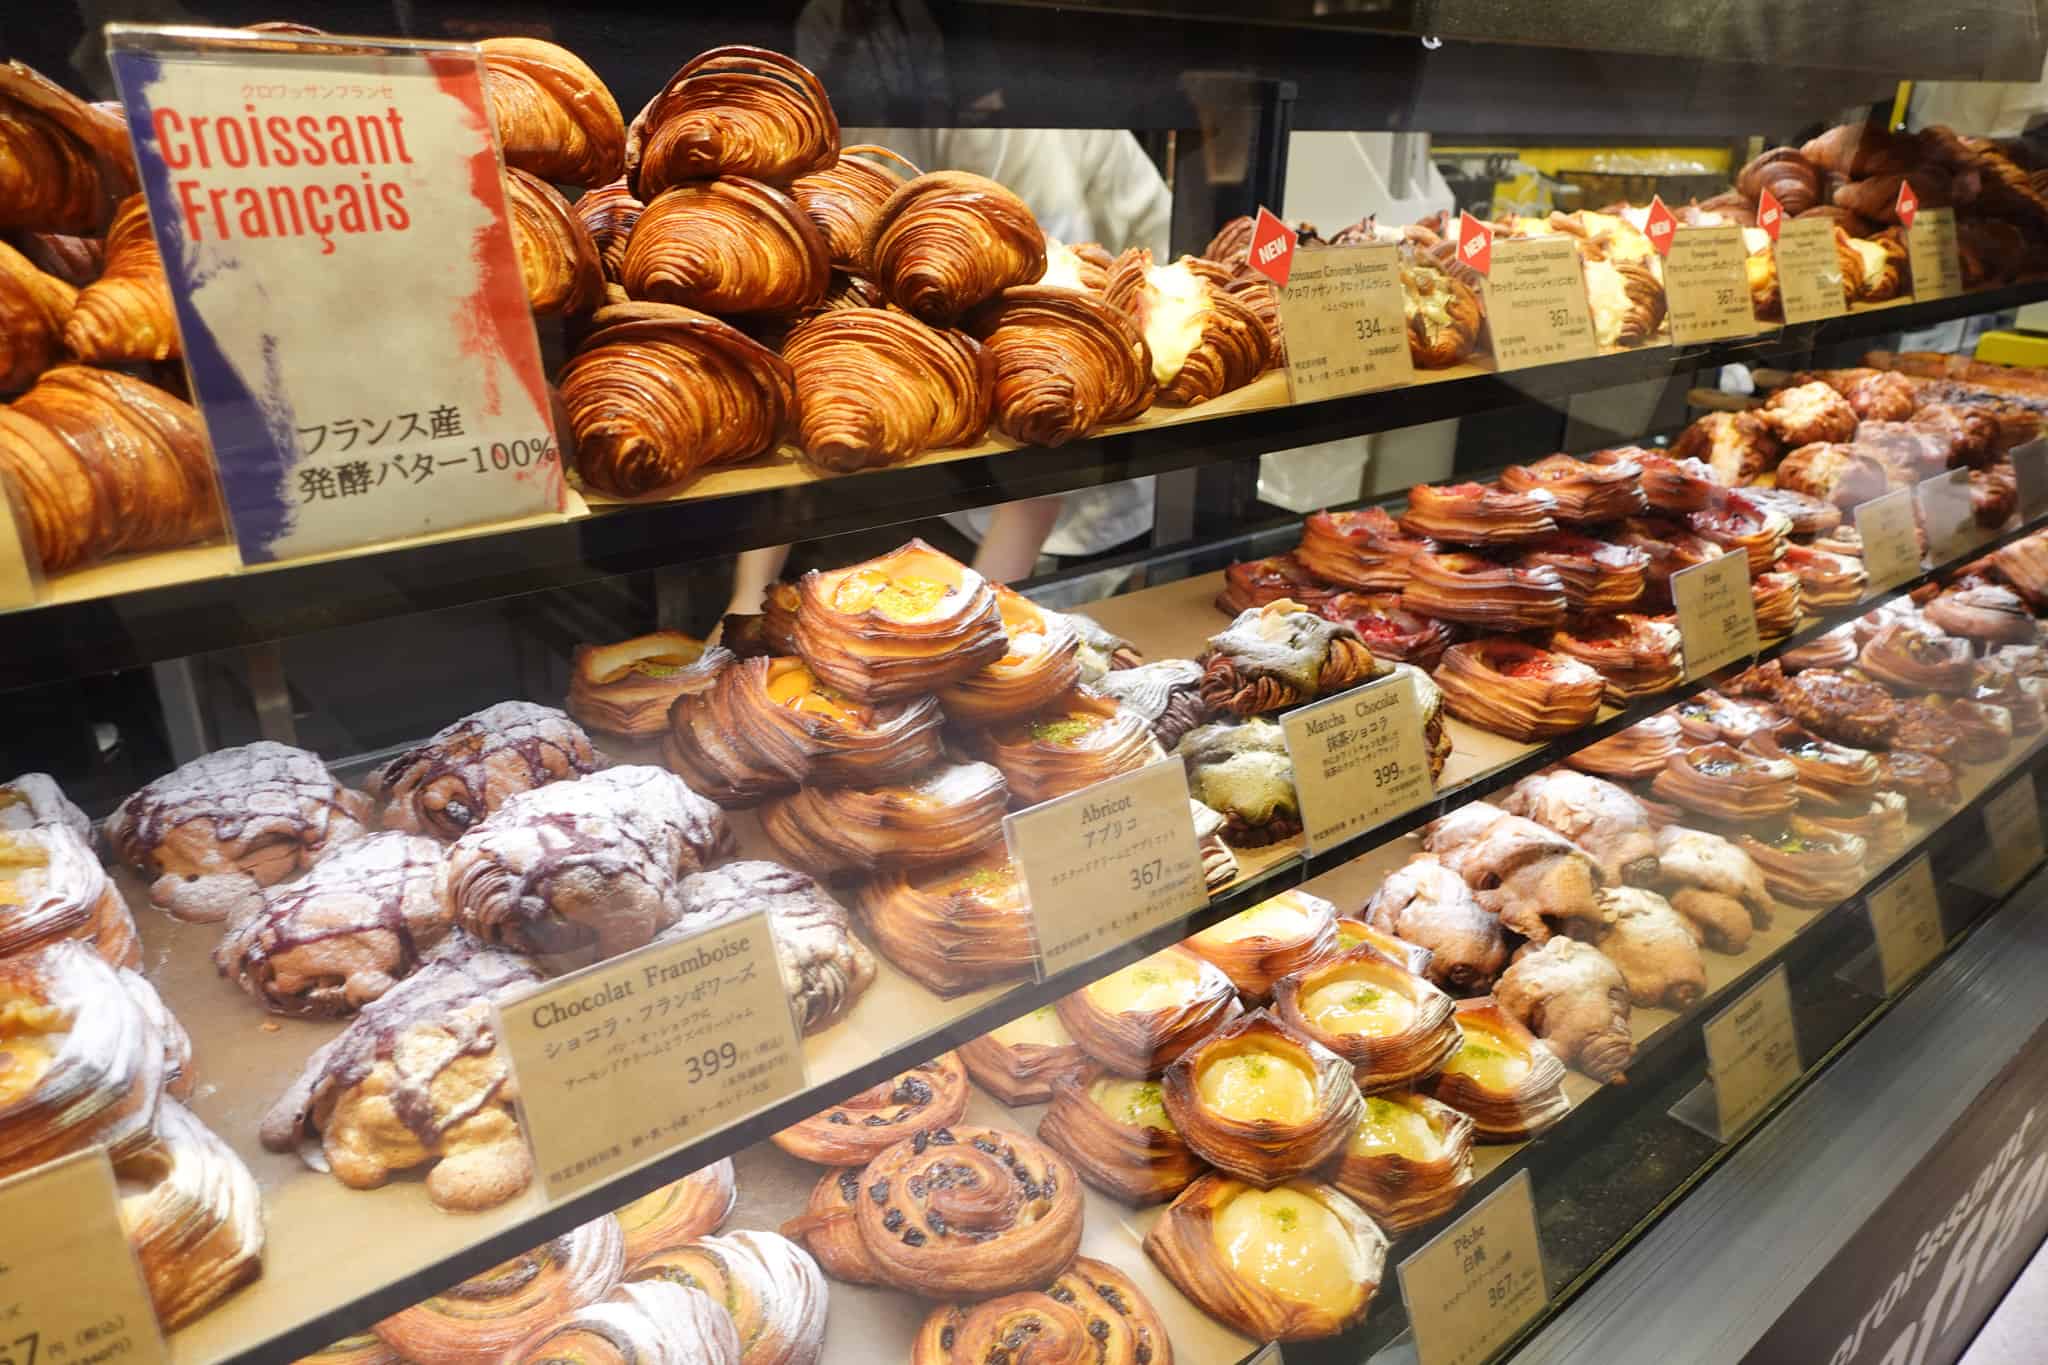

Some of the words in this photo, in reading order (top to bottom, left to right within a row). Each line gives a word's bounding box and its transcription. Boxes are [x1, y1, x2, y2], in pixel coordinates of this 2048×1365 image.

[152, 104, 414, 170] Croissant
[178, 172, 411, 256] Français
[1258, 235, 1288, 265] NEW
[1463, 232, 1488, 259] NEW
[1356, 318, 1382, 340] 334
[298, 403, 466, 456] フランス産
[298, 435, 557, 503] 発酵バター100%
[1305, 712, 1346, 737] Matcha
[1355, 691, 1400, 718] Chocolat
[1373, 761, 1400, 788] 399
[1081, 795, 1132, 825] Abricot
[1129, 858, 1162, 891] 367
[532, 977, 635, 1030] Chocolat
[644, 935, 751, 989] Framboise
[545, 962, 758, 1060] ショコラ・フランボワーズ
[685, 1040, 738, 1085] 399
[1488, 1272, 1513, 1309] 367
